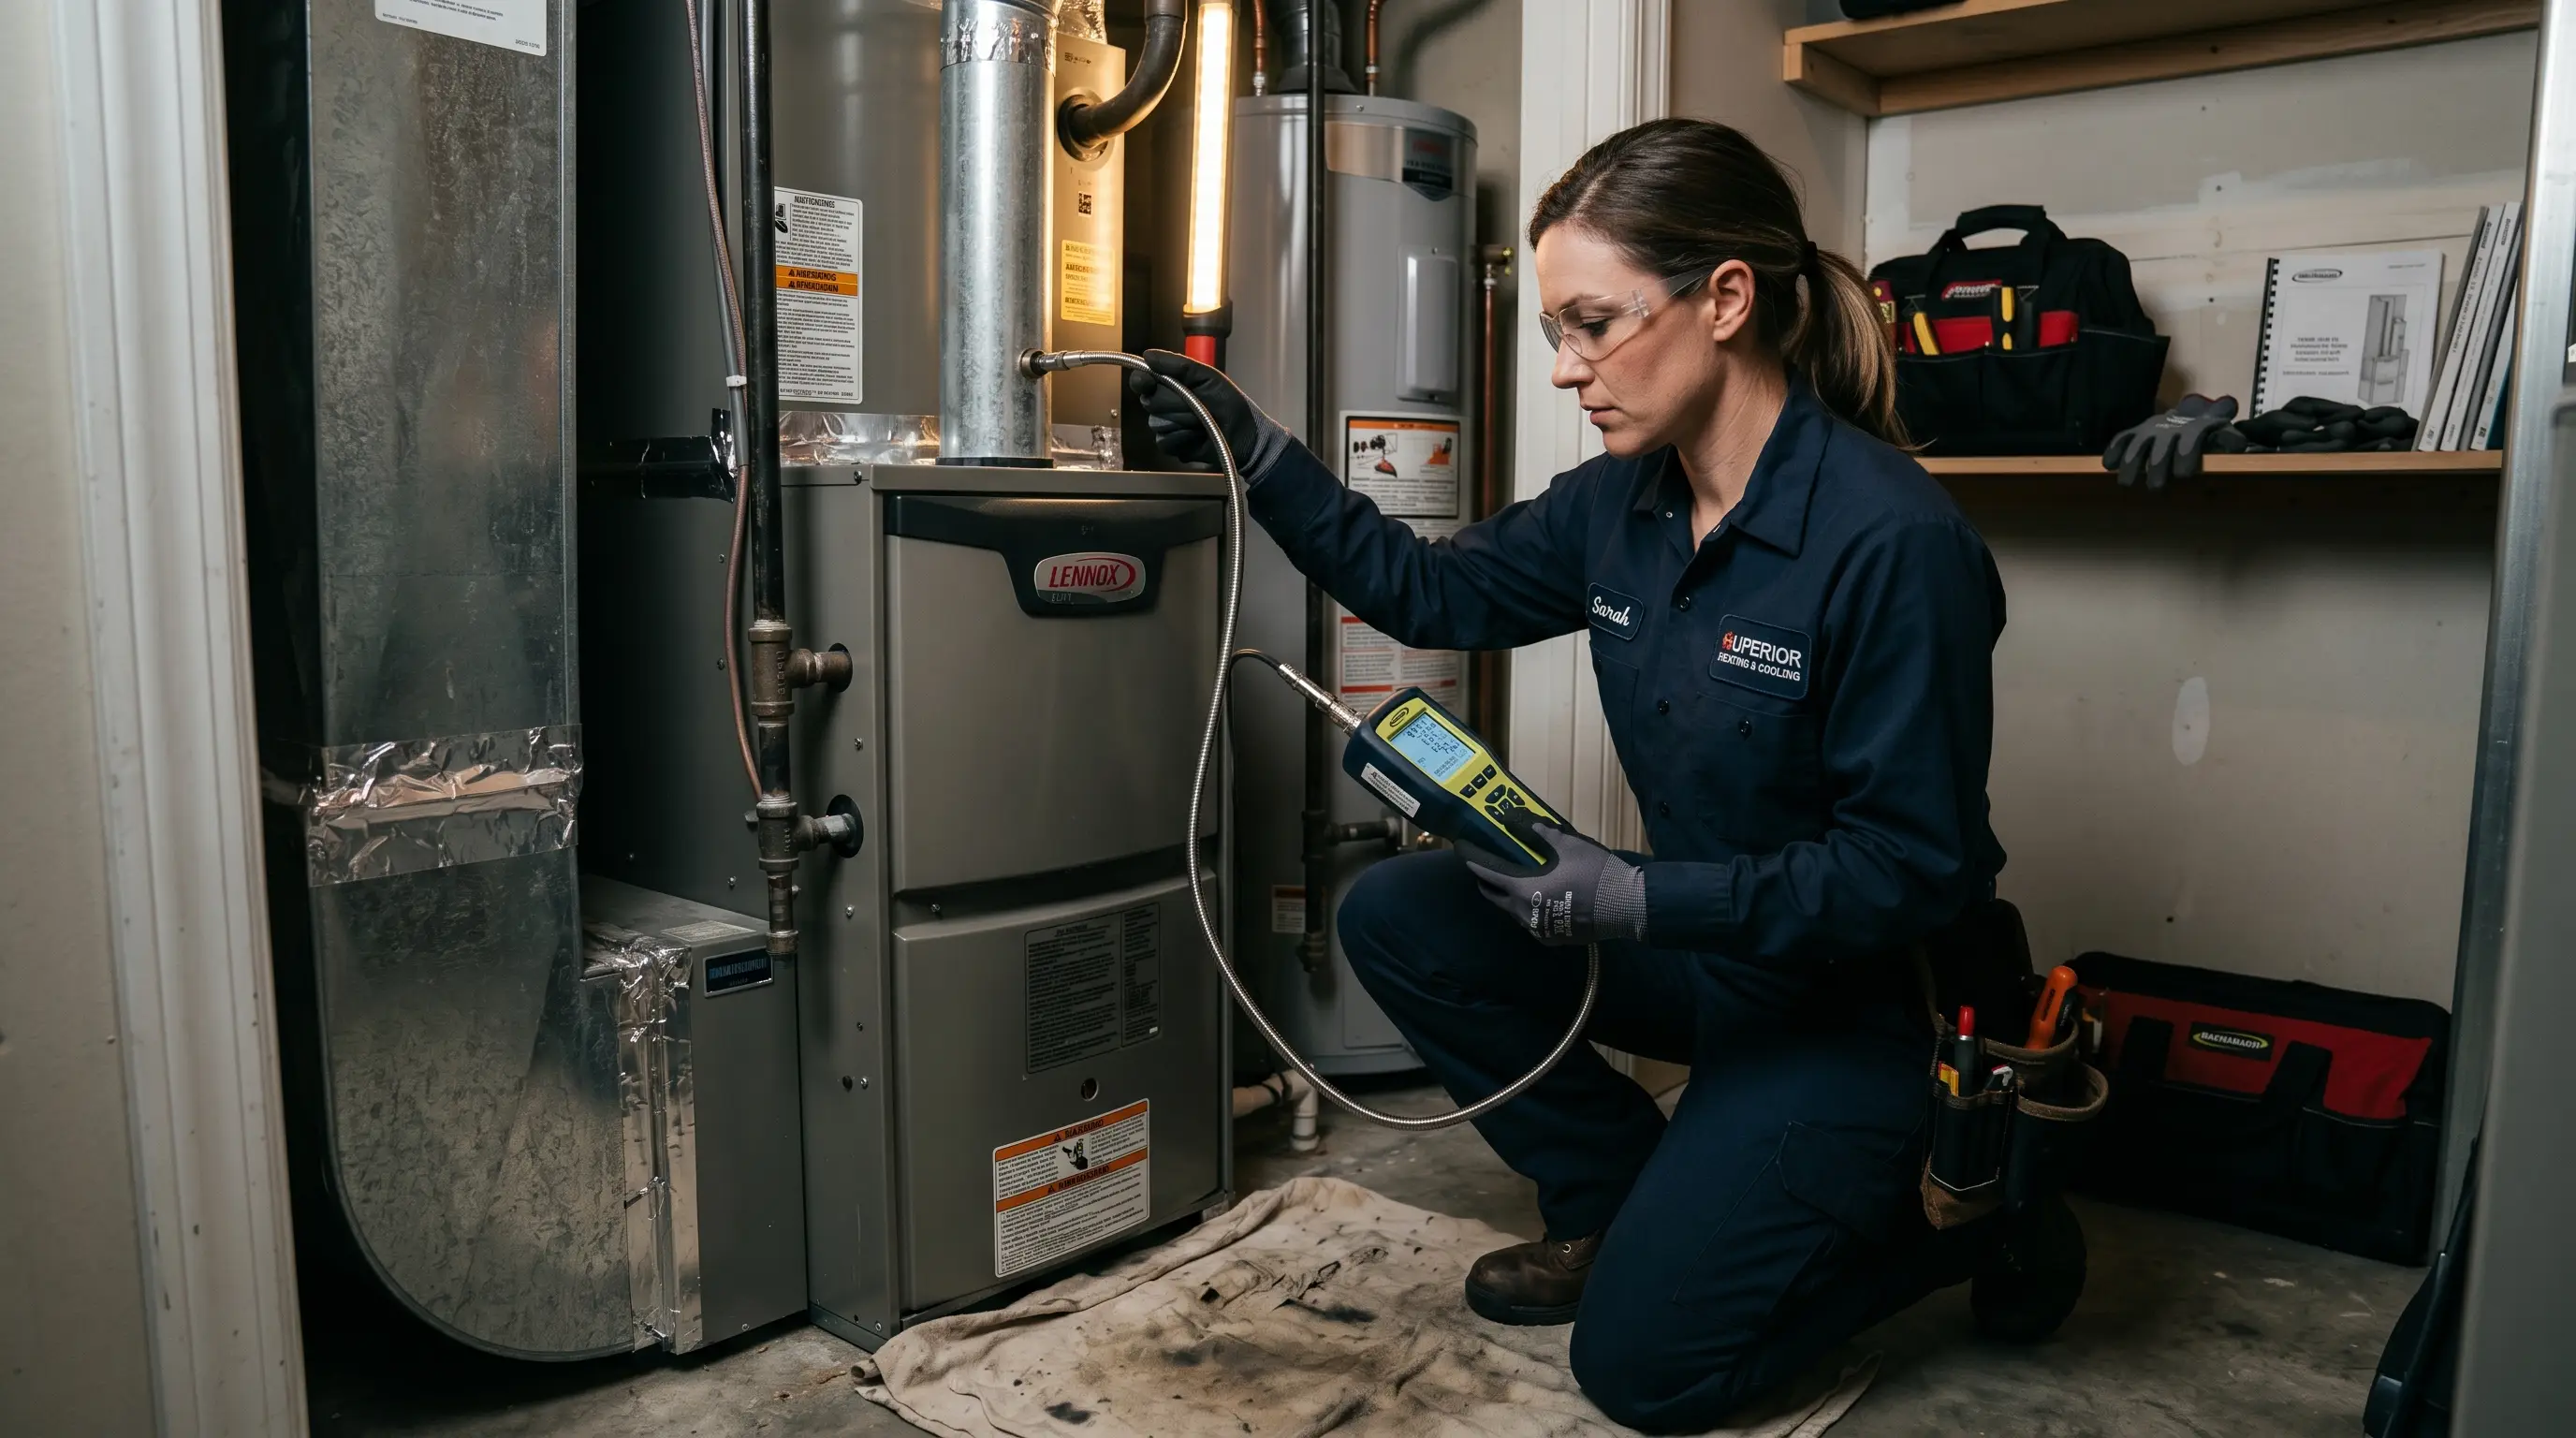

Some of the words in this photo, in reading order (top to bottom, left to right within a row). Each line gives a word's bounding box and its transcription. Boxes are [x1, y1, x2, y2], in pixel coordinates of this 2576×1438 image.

[1048, 565, 1120, 588] LENNOX
[1592, 596, 1631, 626] Sarah
[1758, 663, 1801, 682] COOLING
